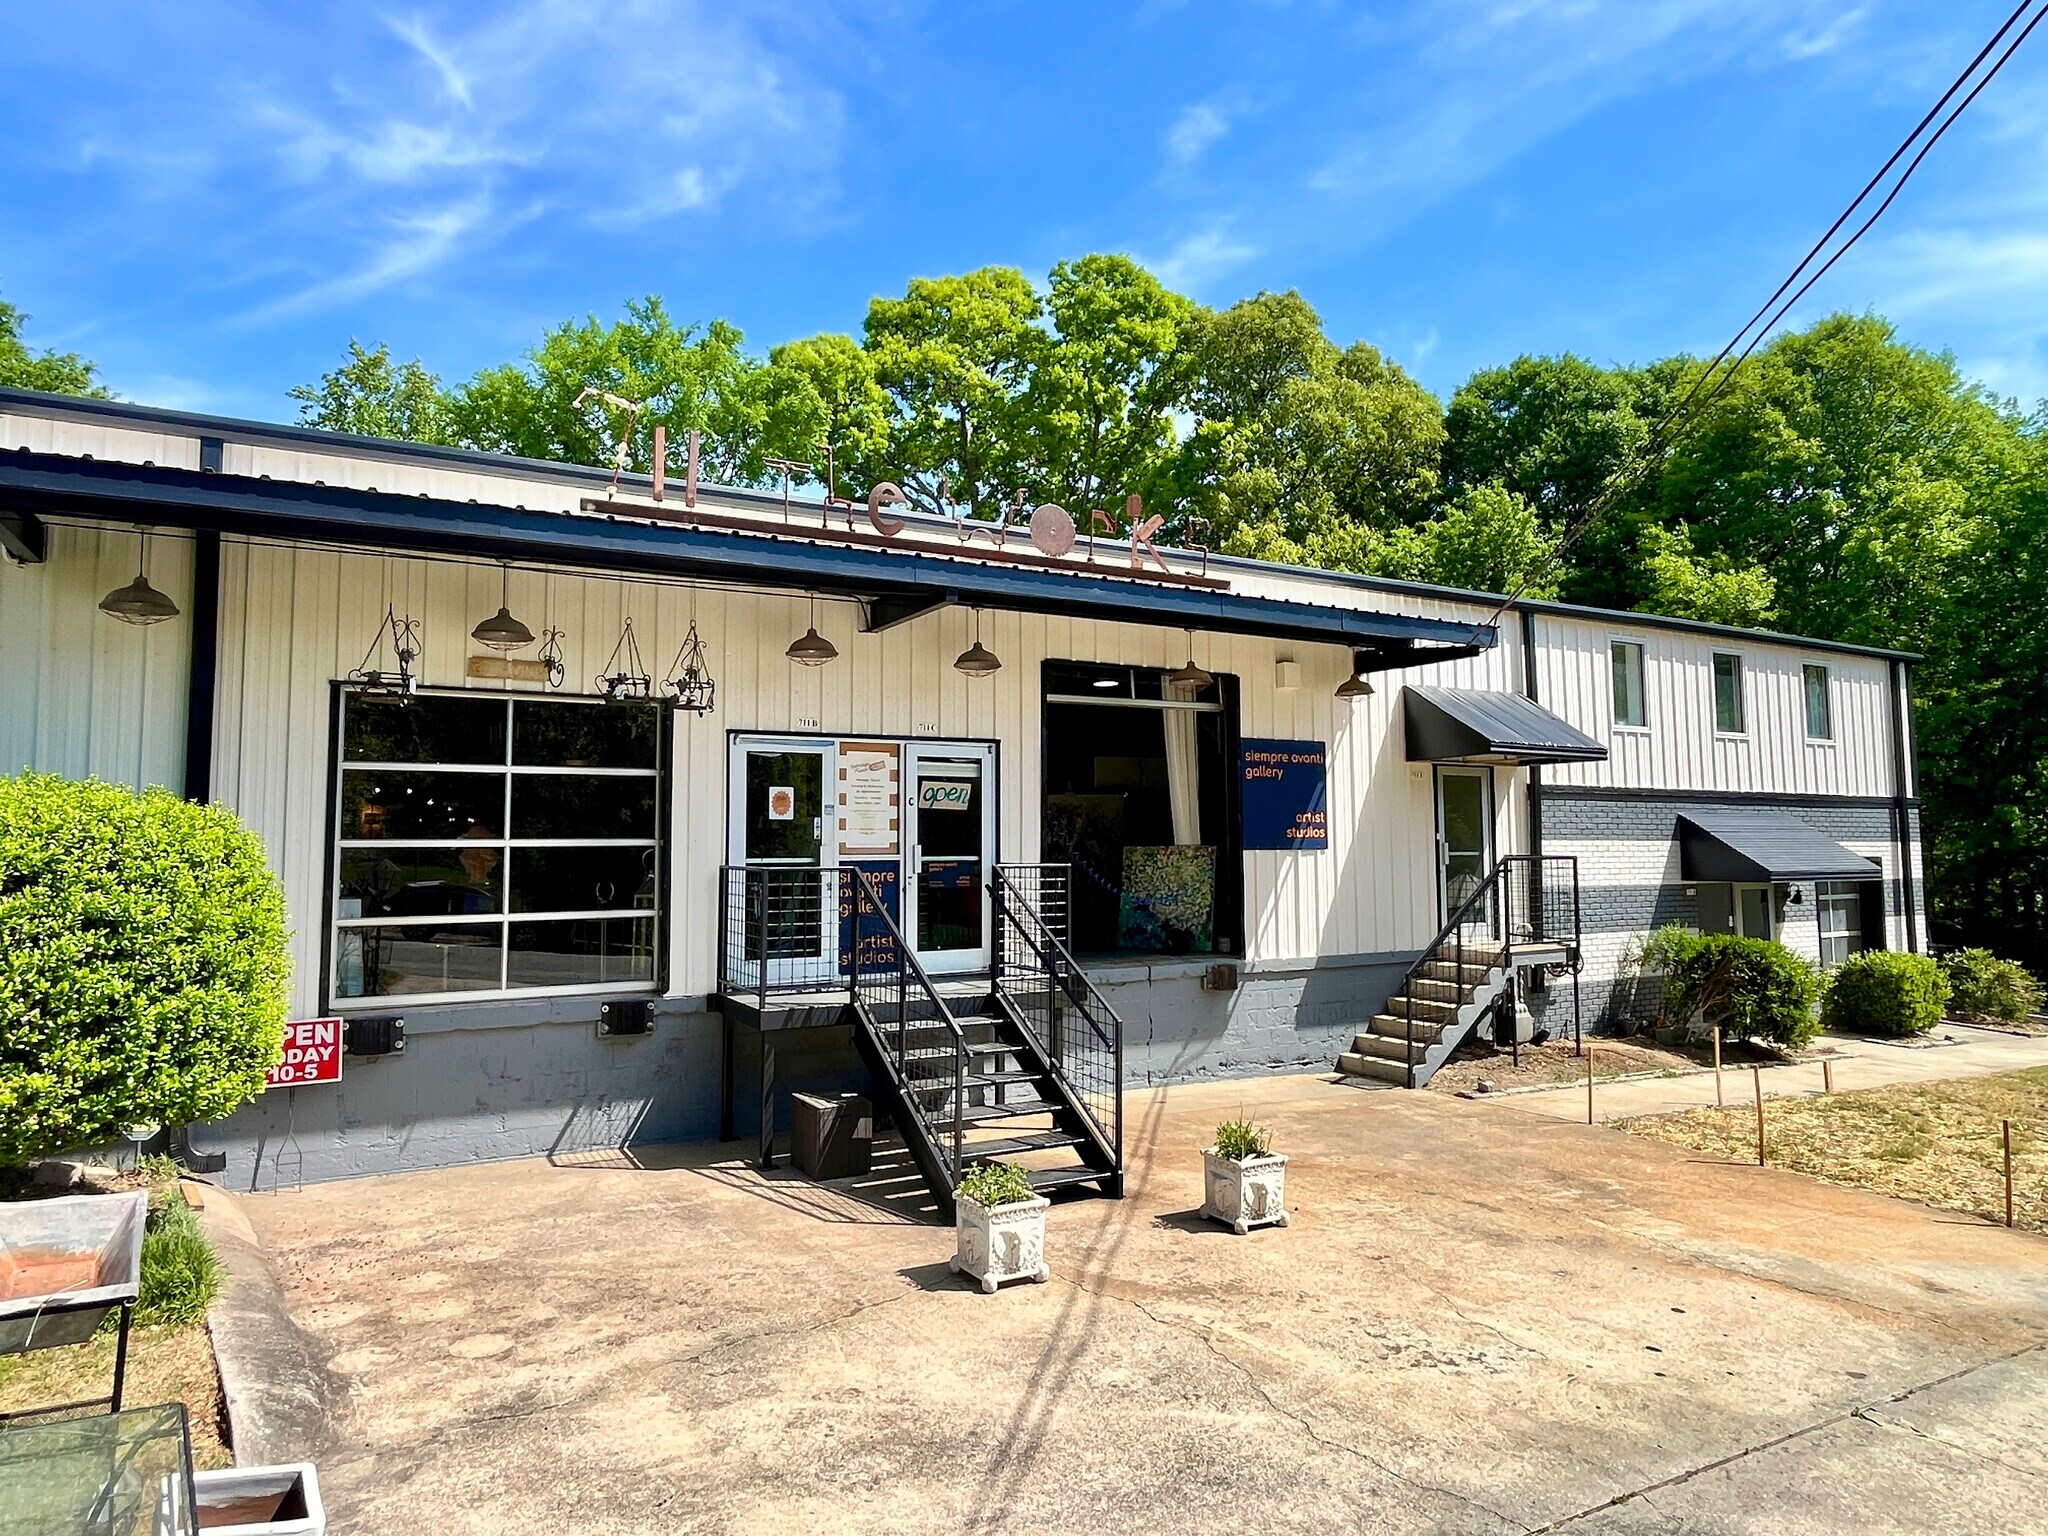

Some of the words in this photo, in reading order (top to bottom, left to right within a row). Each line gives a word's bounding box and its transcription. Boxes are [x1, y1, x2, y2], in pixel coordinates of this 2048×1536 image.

[1245, 750, 1289, 765] siempre
[1291, 752, 1324, 764] avanti
[1245, 766, 1283, 780] gallery
[922, 786, 969, 808] open
[1296, 811, 1325, 824] artist
[1286, 826, 1325, 838] studios
[840, 872, 895, 886] simpre
[282, 1023, 335, 1046] PEN
[281, 1046, 336, 1064] DAY
[269, 1064, 318, 1082] 10-5
